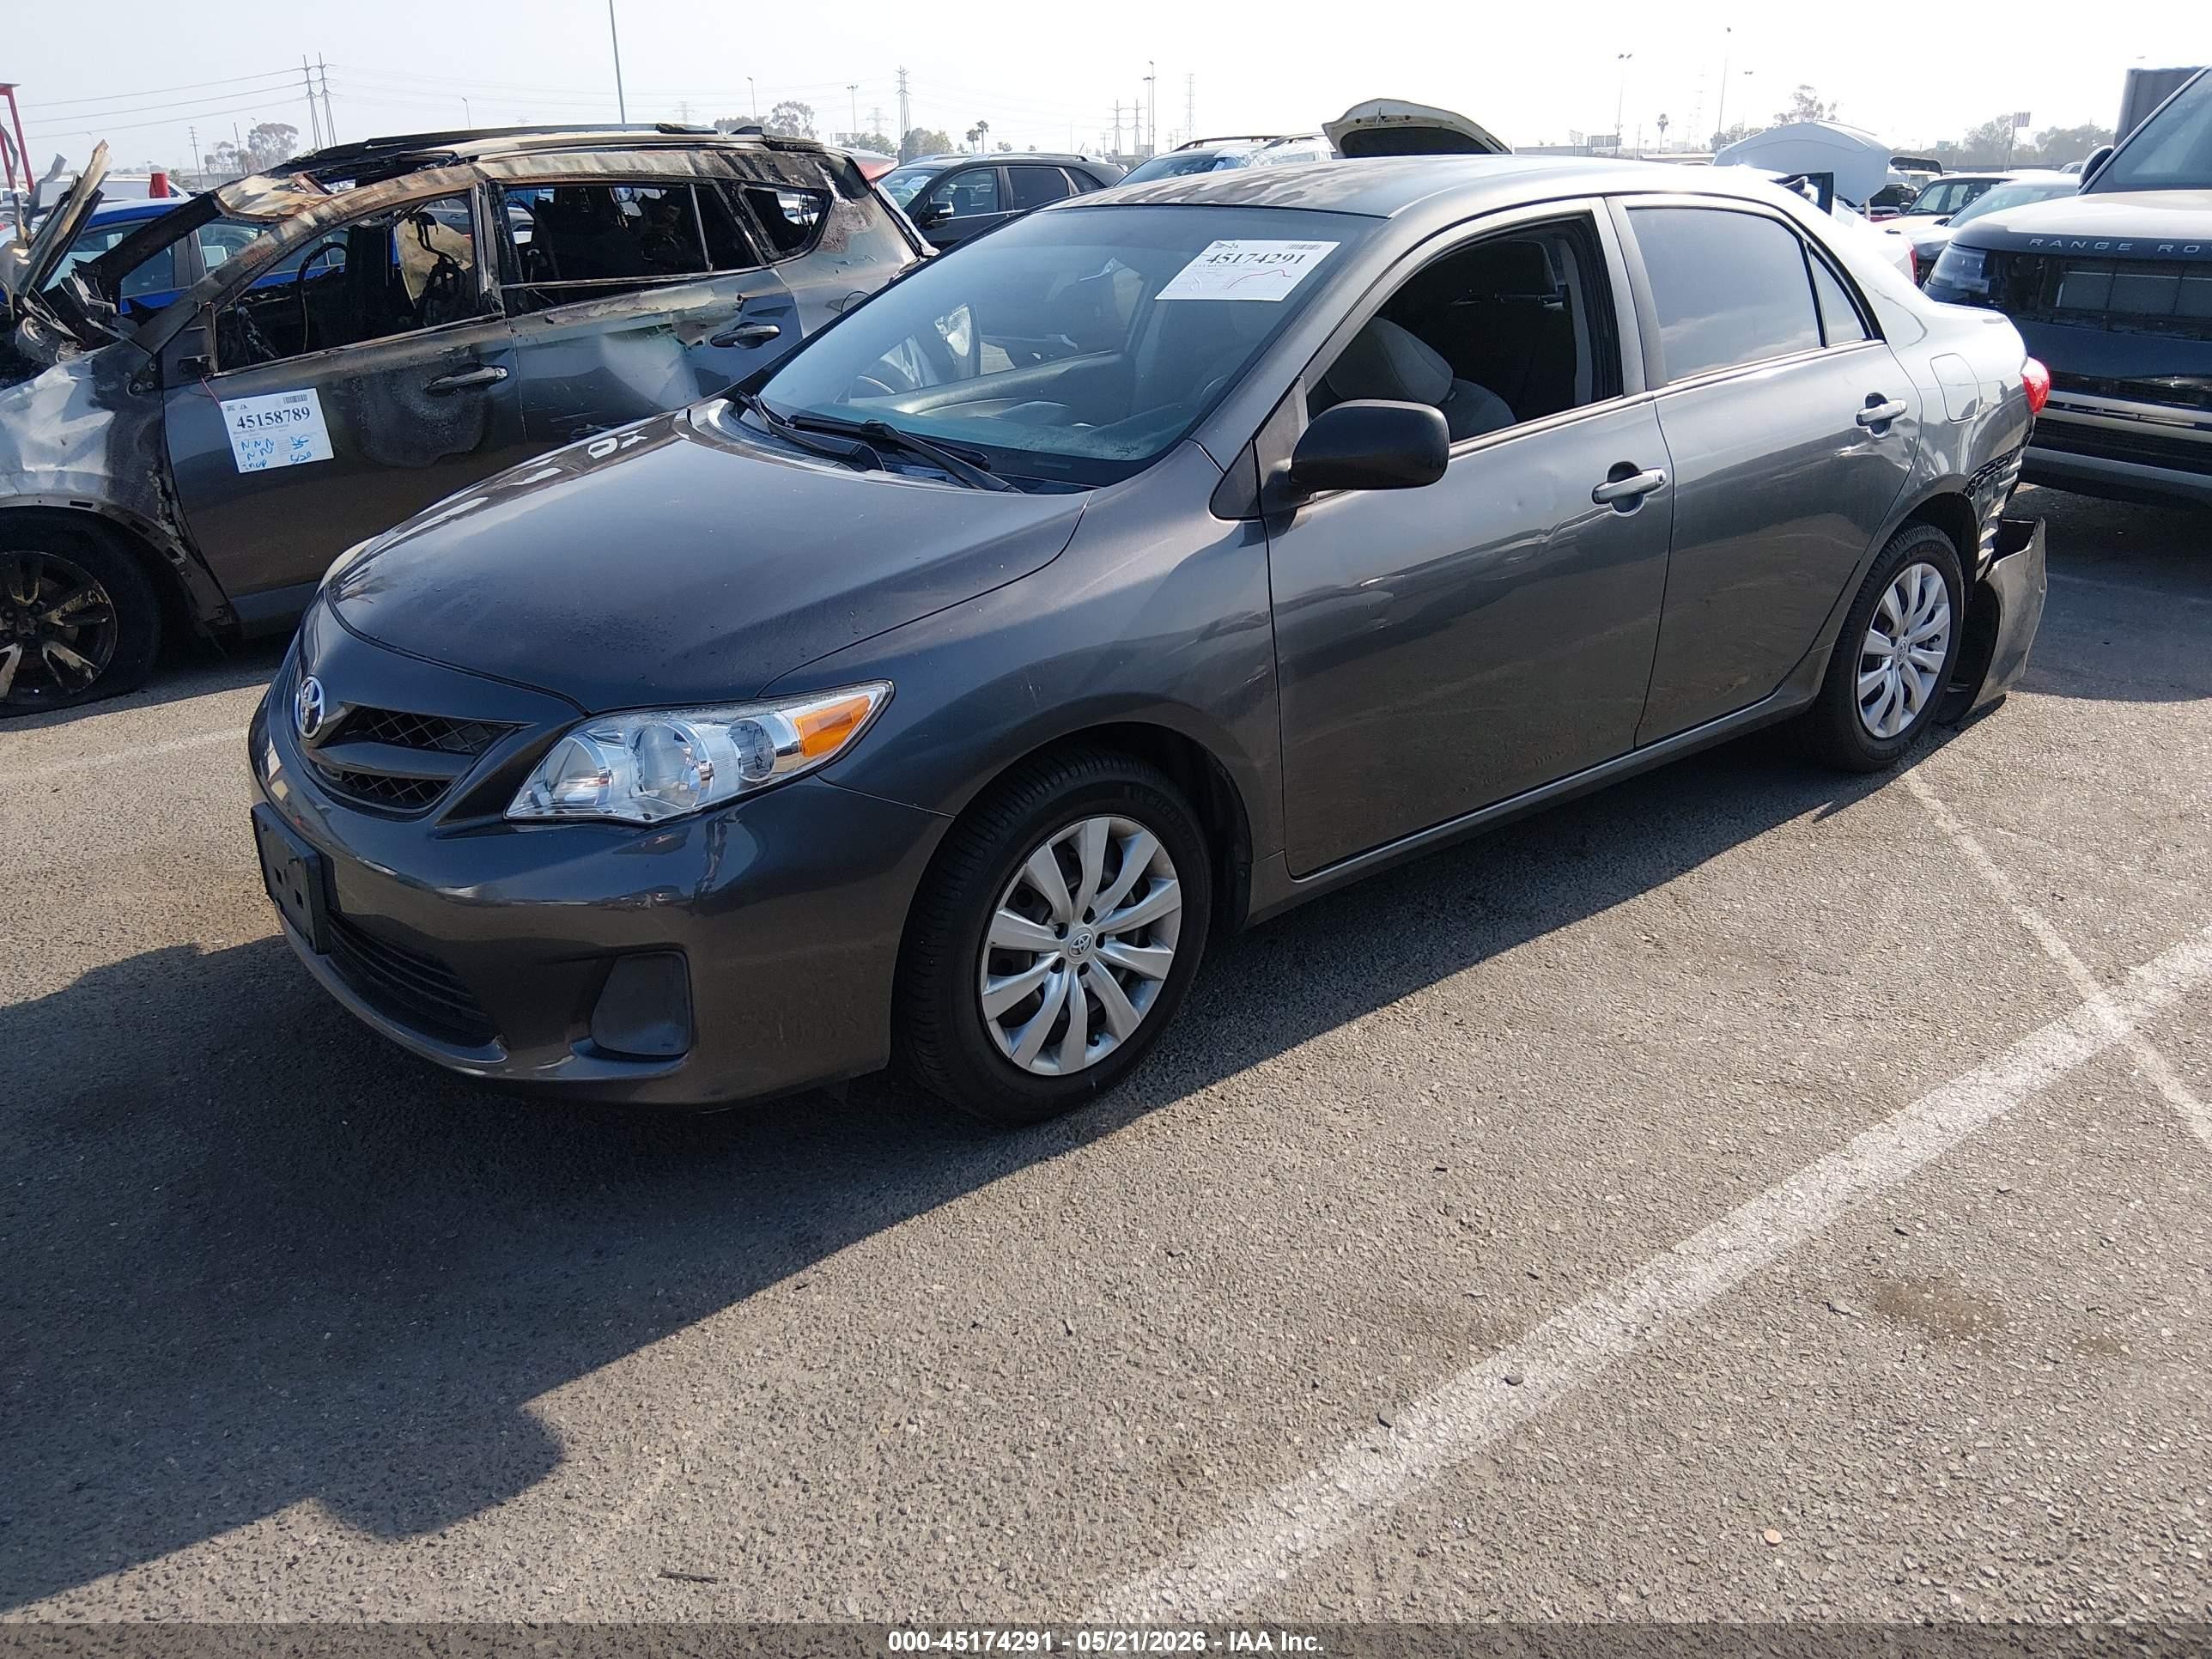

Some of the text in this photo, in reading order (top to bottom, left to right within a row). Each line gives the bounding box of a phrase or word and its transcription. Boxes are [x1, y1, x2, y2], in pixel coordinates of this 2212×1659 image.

[2029, 238, 2212, 254] RANGE RO
[1206, 252, 1306, 265] 45174291
[236, 406, 311, 429] 45158789
